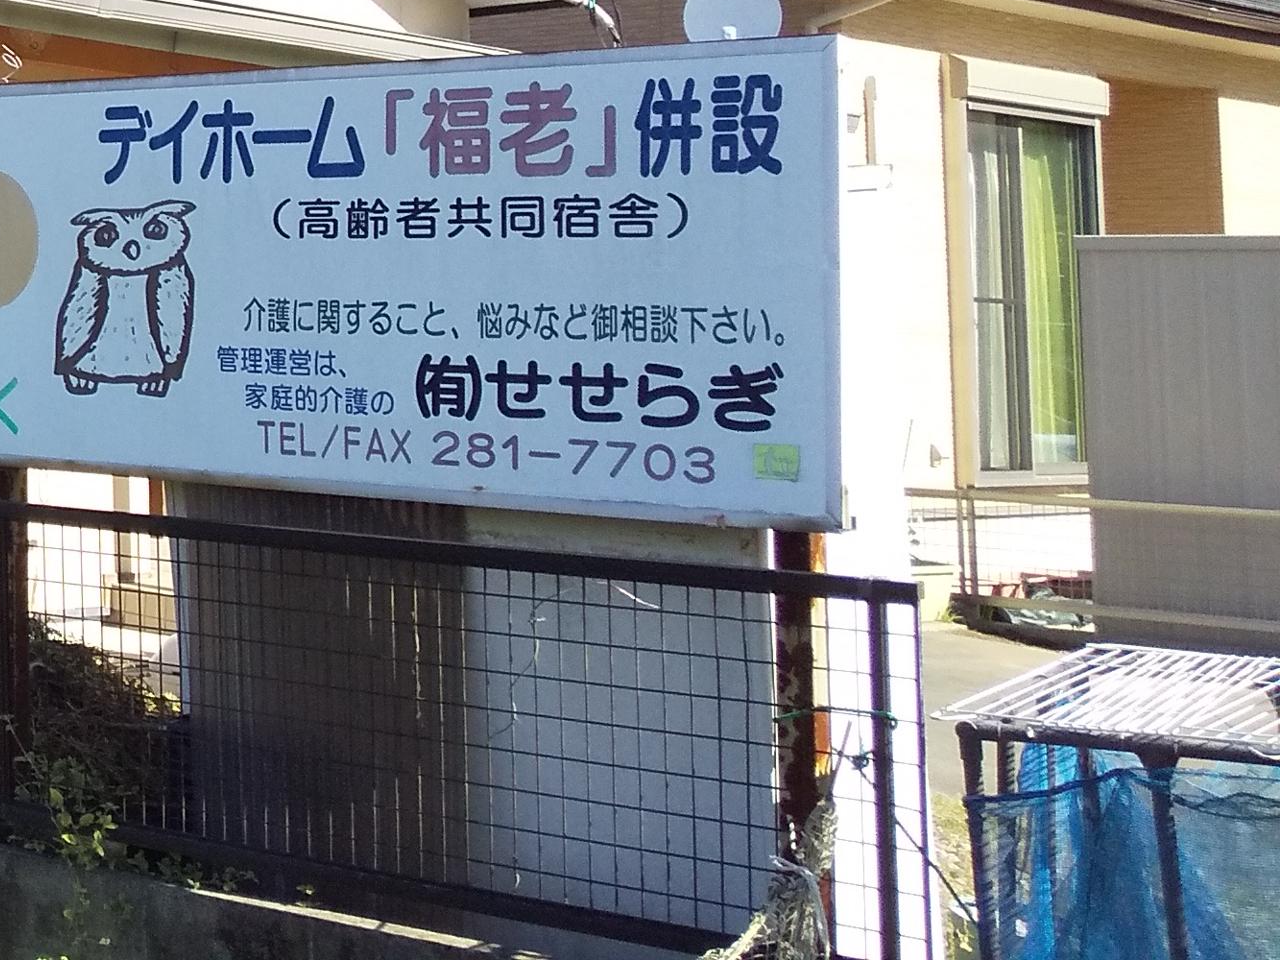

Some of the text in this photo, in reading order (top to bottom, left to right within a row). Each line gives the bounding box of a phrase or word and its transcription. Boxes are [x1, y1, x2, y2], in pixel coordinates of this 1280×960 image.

[242, 296, 786, 347] 介護に関すること、悩みなど御相談下さい。
[215, 345, 348, 378] 管理運営は、
[243, 382, 396, 417] 家庭的介護の
[256, 419, 413, 465] TEL/FAX
[431, 429, 718, 485] 281-7703
